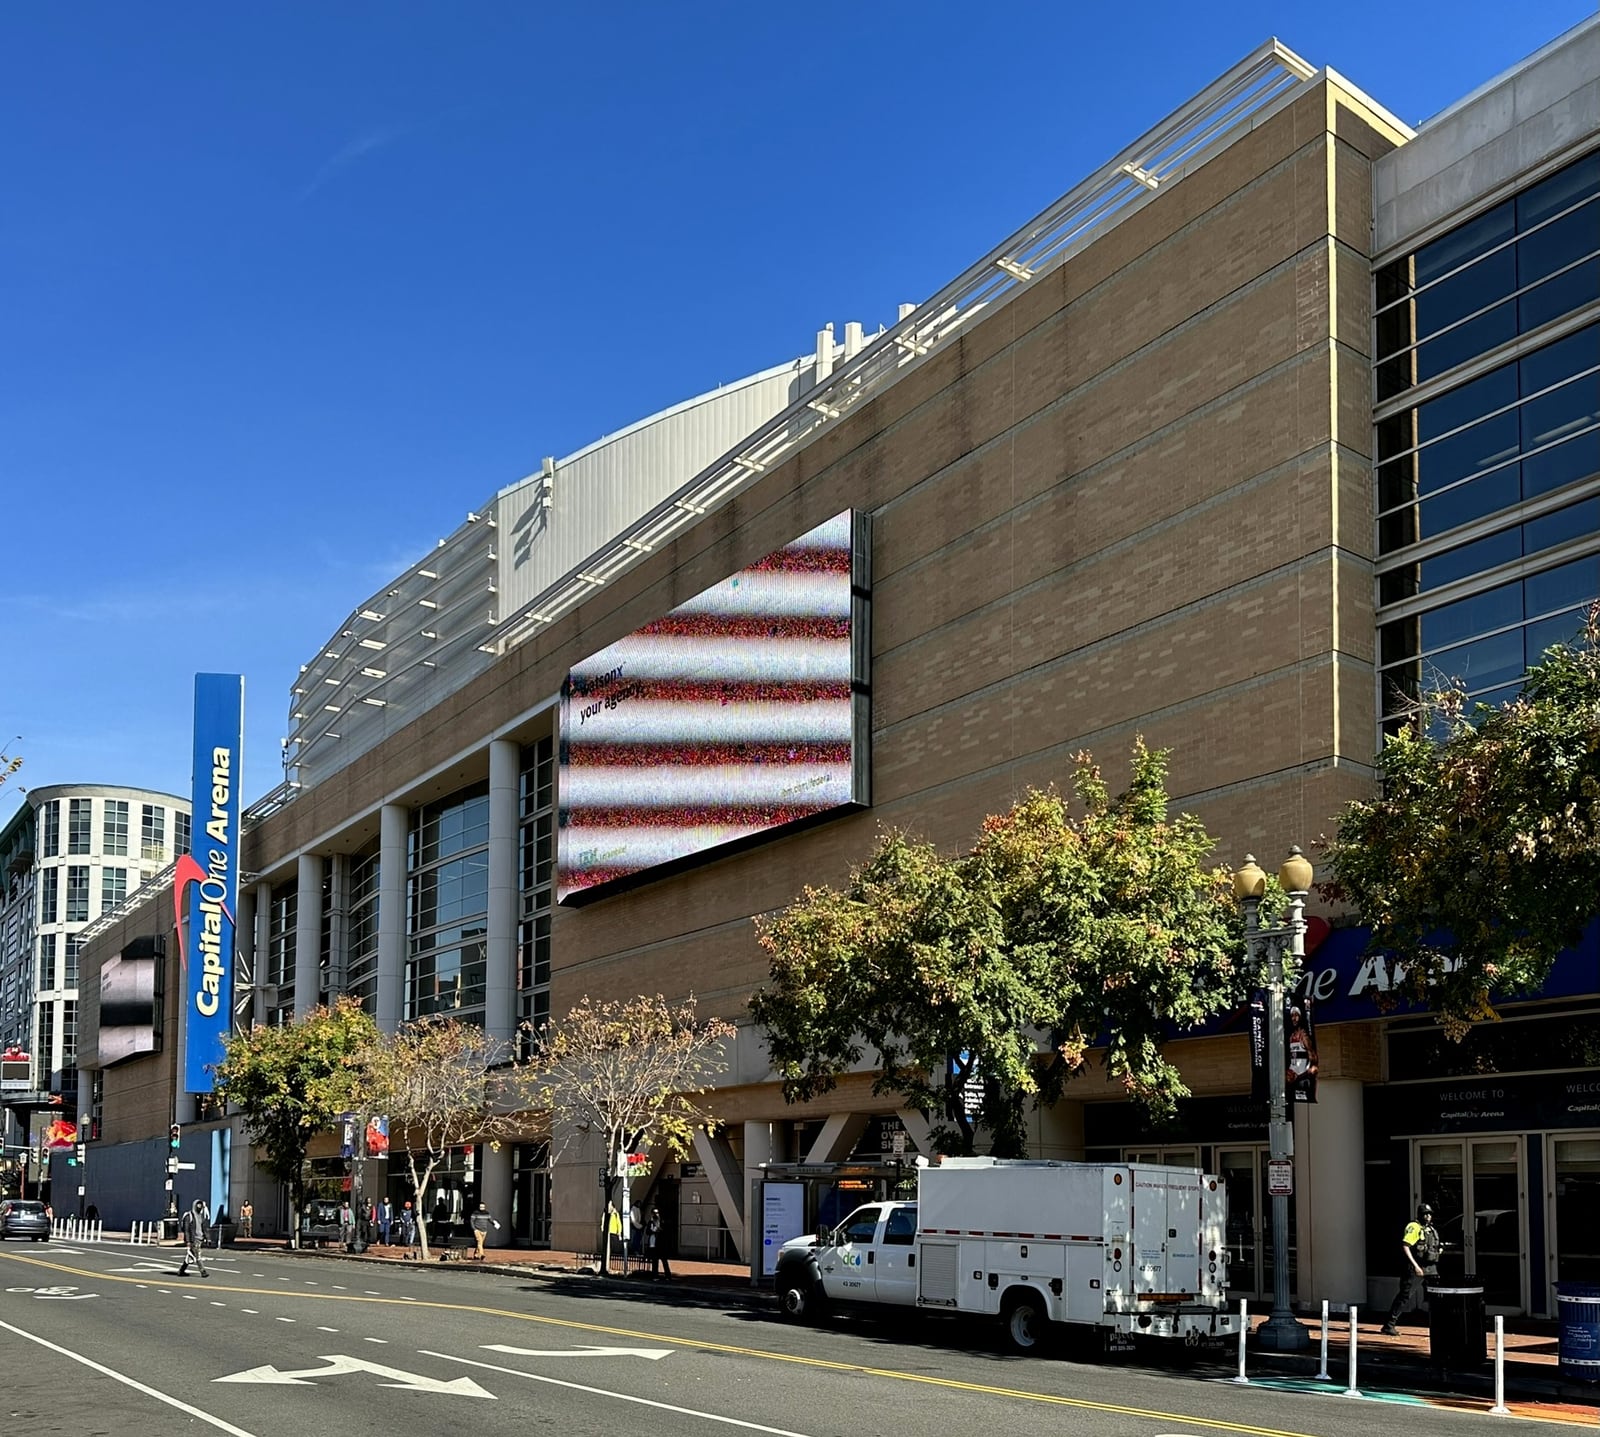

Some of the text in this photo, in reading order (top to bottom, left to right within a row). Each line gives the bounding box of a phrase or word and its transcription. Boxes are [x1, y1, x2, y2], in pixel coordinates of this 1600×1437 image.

[580, 700, 602, 725] your
[206, 746, 231, 845] Arena
[1440, 1089, 1505, 1101] WELCOME TO
[1480, 1110, 1505, 1118] Arena
[881, 1121, 900, 1131] THE
[881, 1140, 910, 1150] SHP
